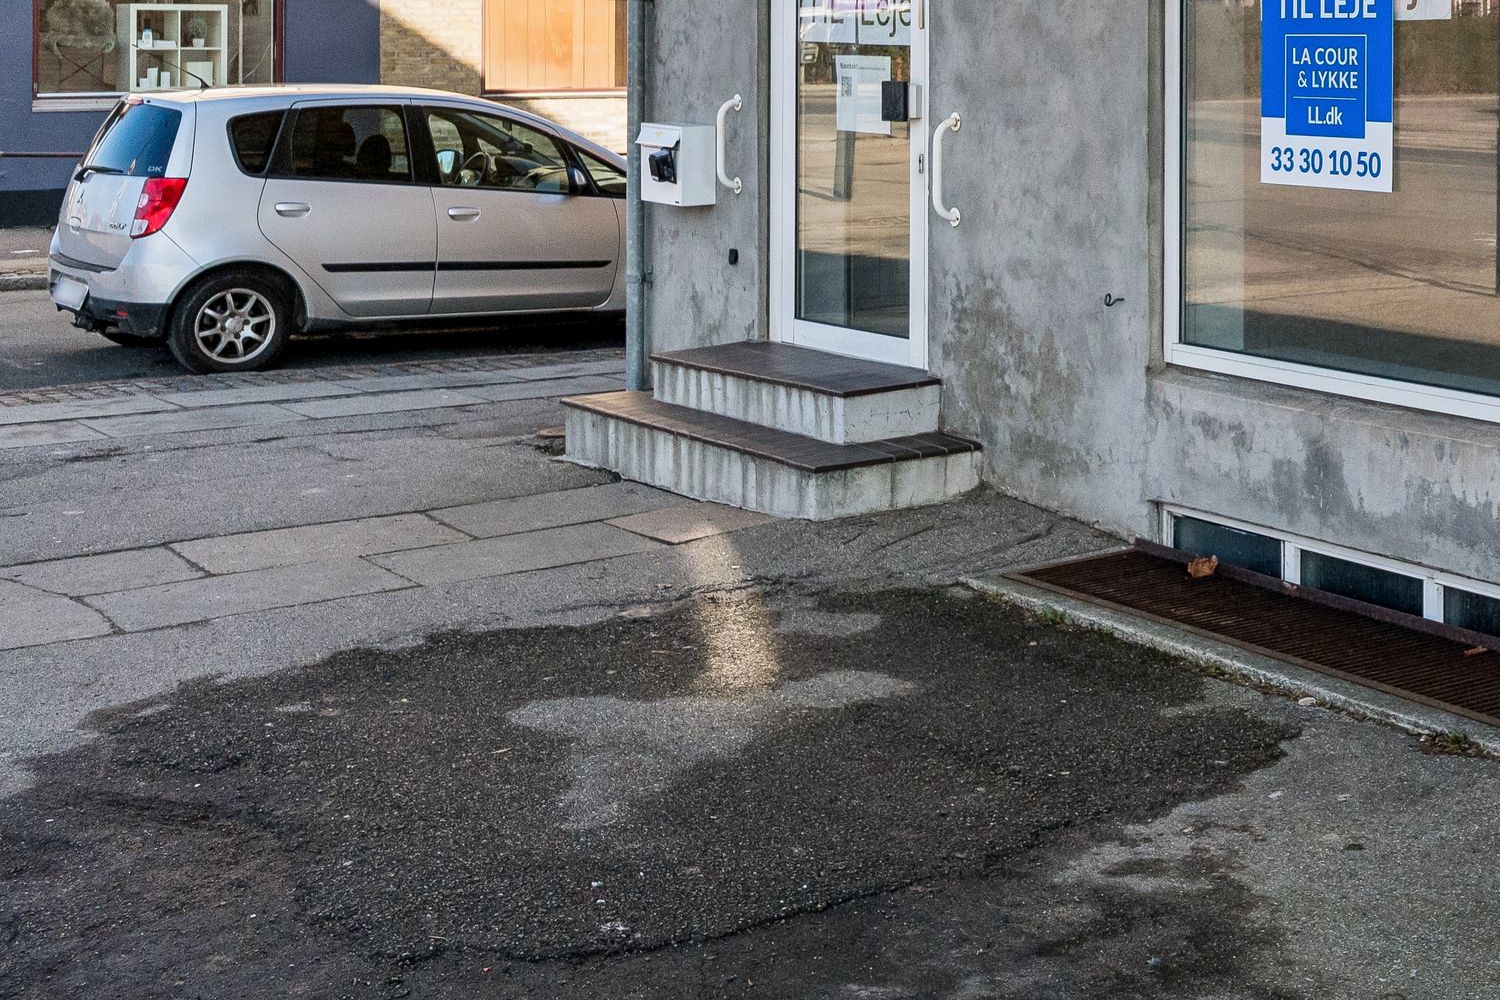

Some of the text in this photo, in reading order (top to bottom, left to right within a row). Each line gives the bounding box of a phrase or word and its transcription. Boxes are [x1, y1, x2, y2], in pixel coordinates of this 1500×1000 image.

[1292, 47, 1359, 66] LA COUR
[1297, 70, 1358, 89] & LYKKE
[1308, 105, 1343, 126] LL.dk
[147, 165, 163, 173] DK
[1270, 146, 1382, 179] 33 30 10 50
